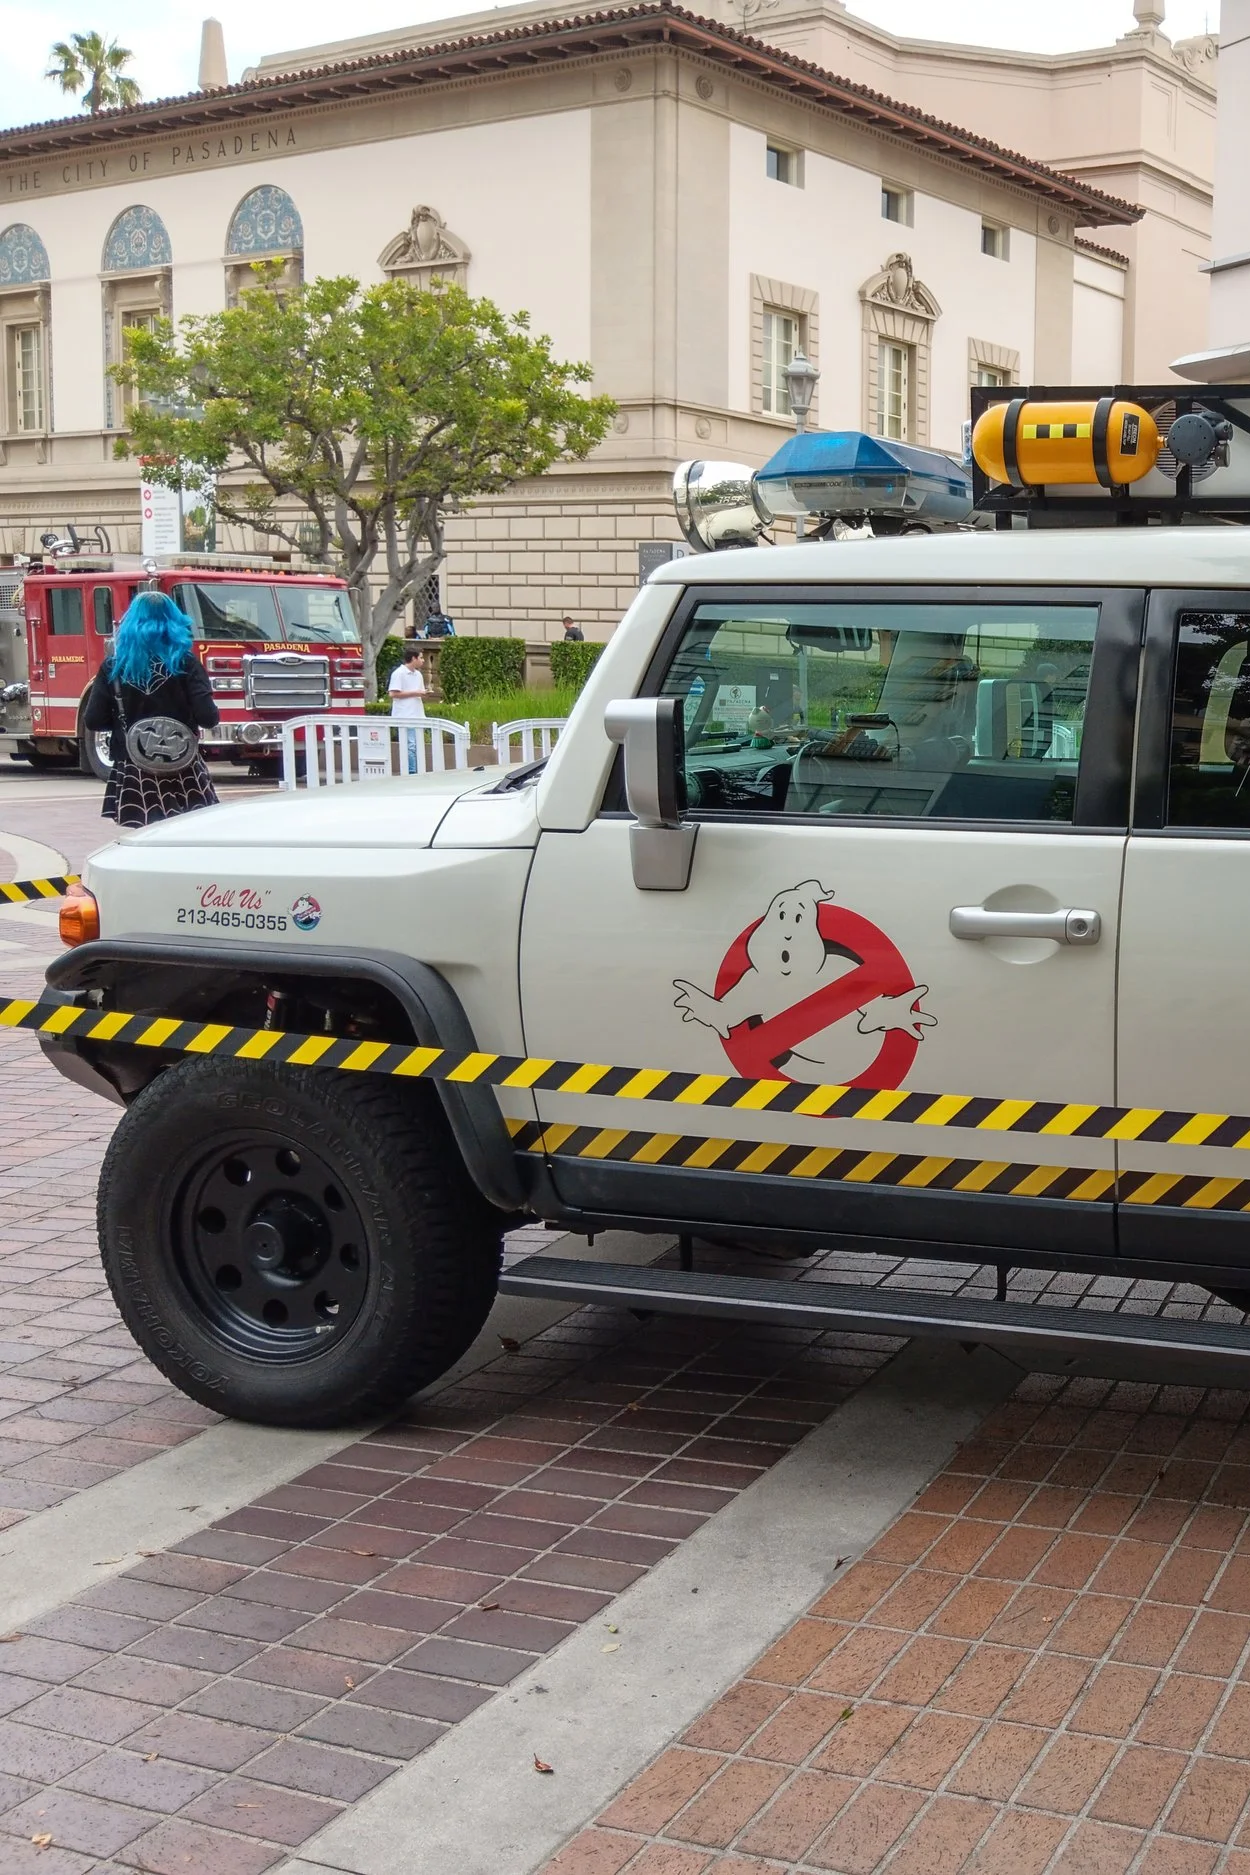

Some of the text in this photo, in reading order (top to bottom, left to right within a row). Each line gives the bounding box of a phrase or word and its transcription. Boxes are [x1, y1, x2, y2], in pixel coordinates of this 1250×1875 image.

[7, 128, 297, 193] THE CITY OF PASADENA
[263, 642, 310, 653] PASADENA
[51, 655, 85, 663] PARAMEDIC
[177, 908, 287, 931] 213-465-0355
